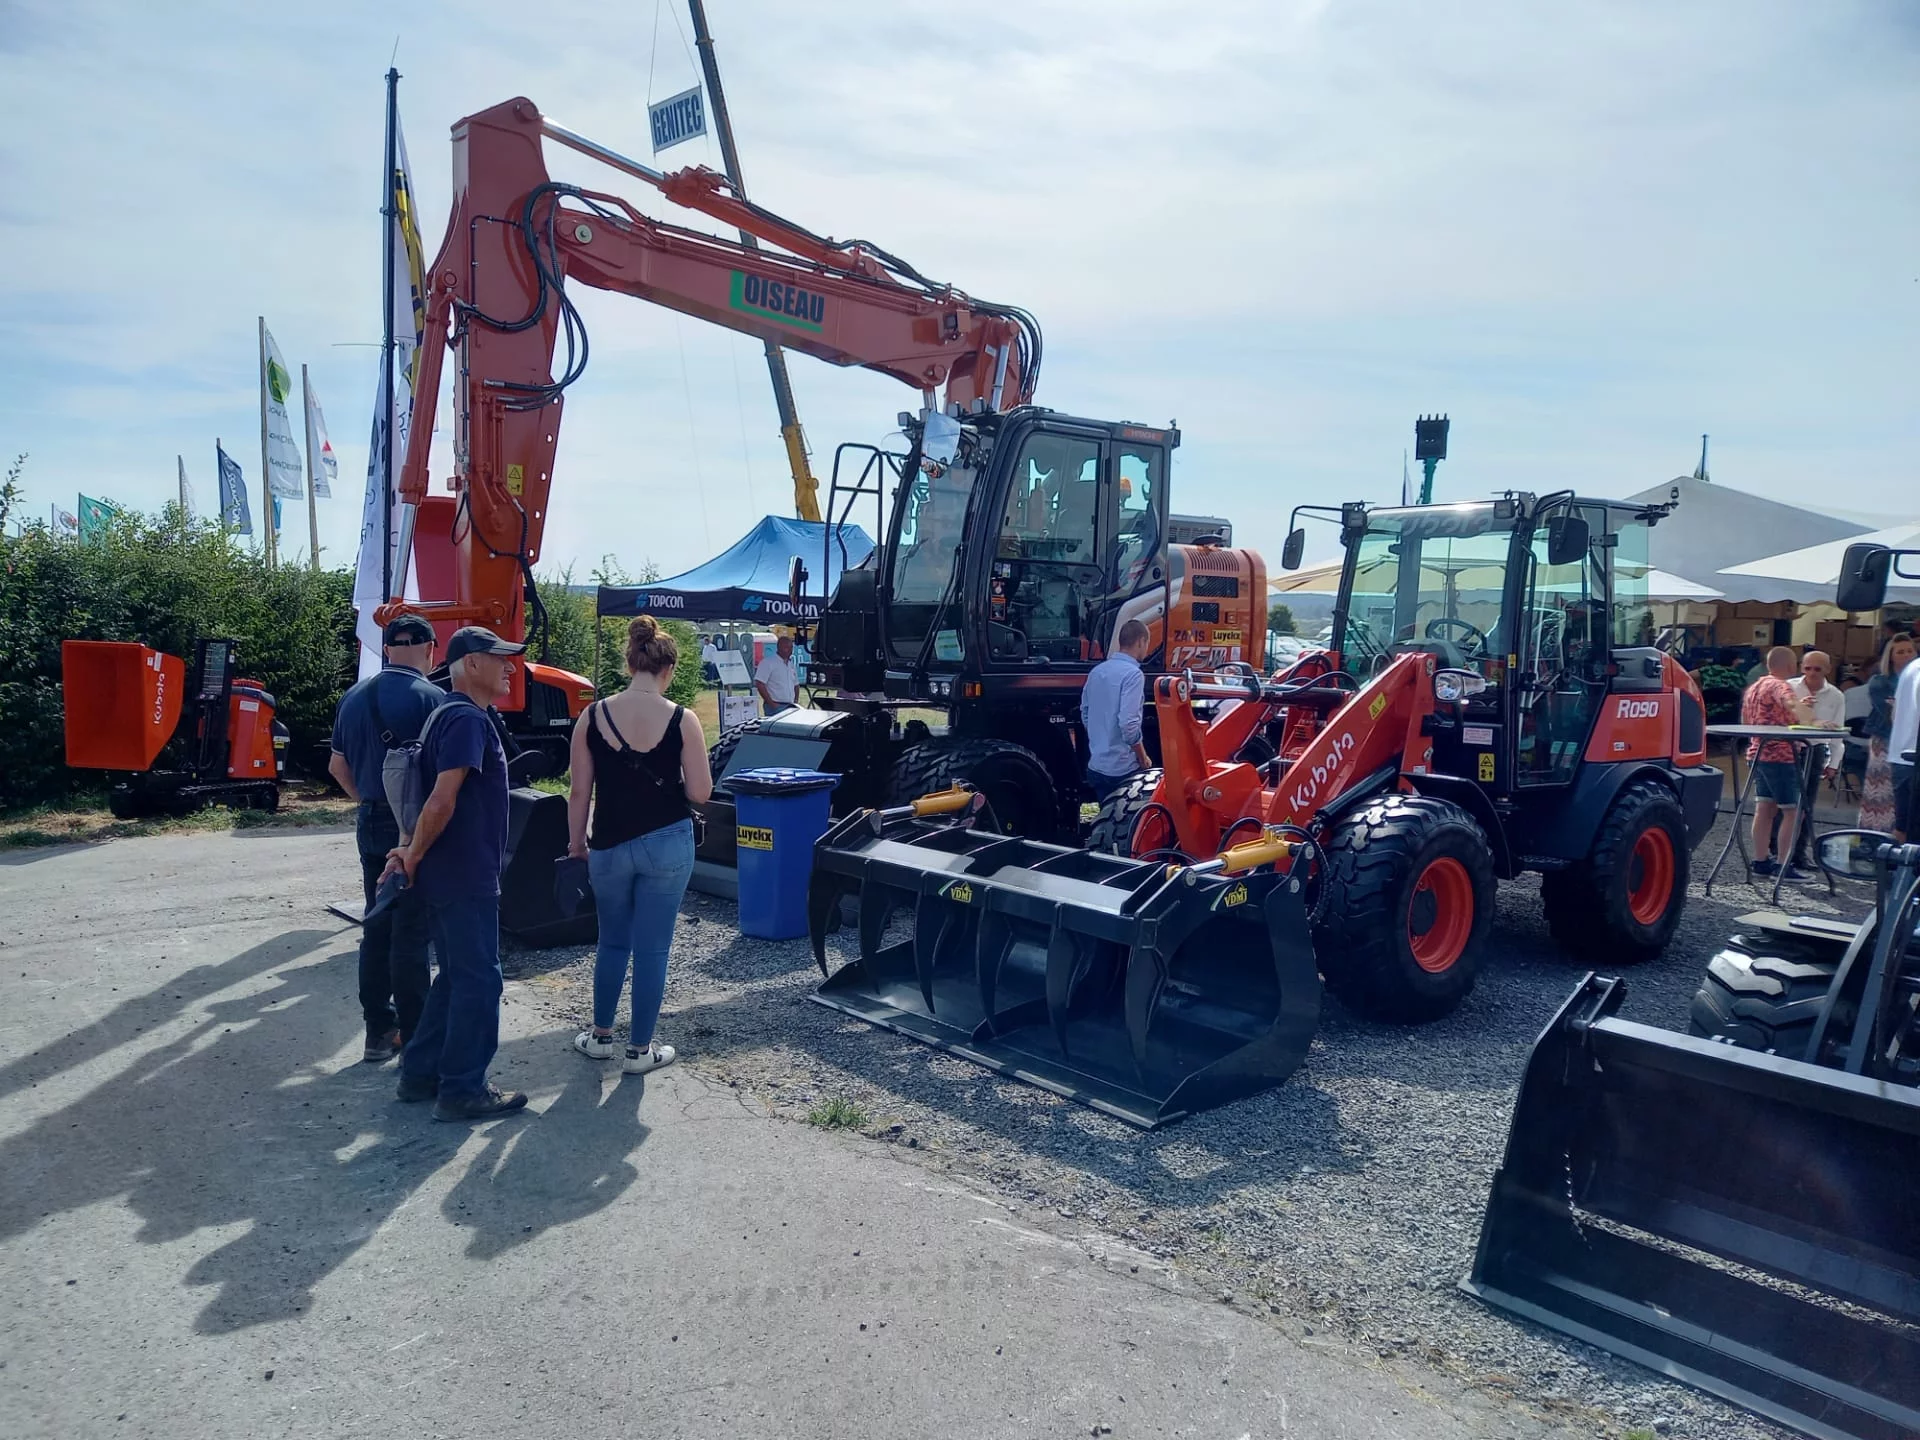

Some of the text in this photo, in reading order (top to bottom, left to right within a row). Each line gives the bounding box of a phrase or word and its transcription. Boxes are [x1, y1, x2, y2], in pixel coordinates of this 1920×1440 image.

[652, 94, 701, 146] GENITEC
[648, 594, 684, 609] TOPCON
[1213, 630, 1241, 642] Luyckx
[153, 673, 165, 725] Kubota
[1289, 732, 1355, 812] Kubota
[737, 826, 772, 842] Luyckx
